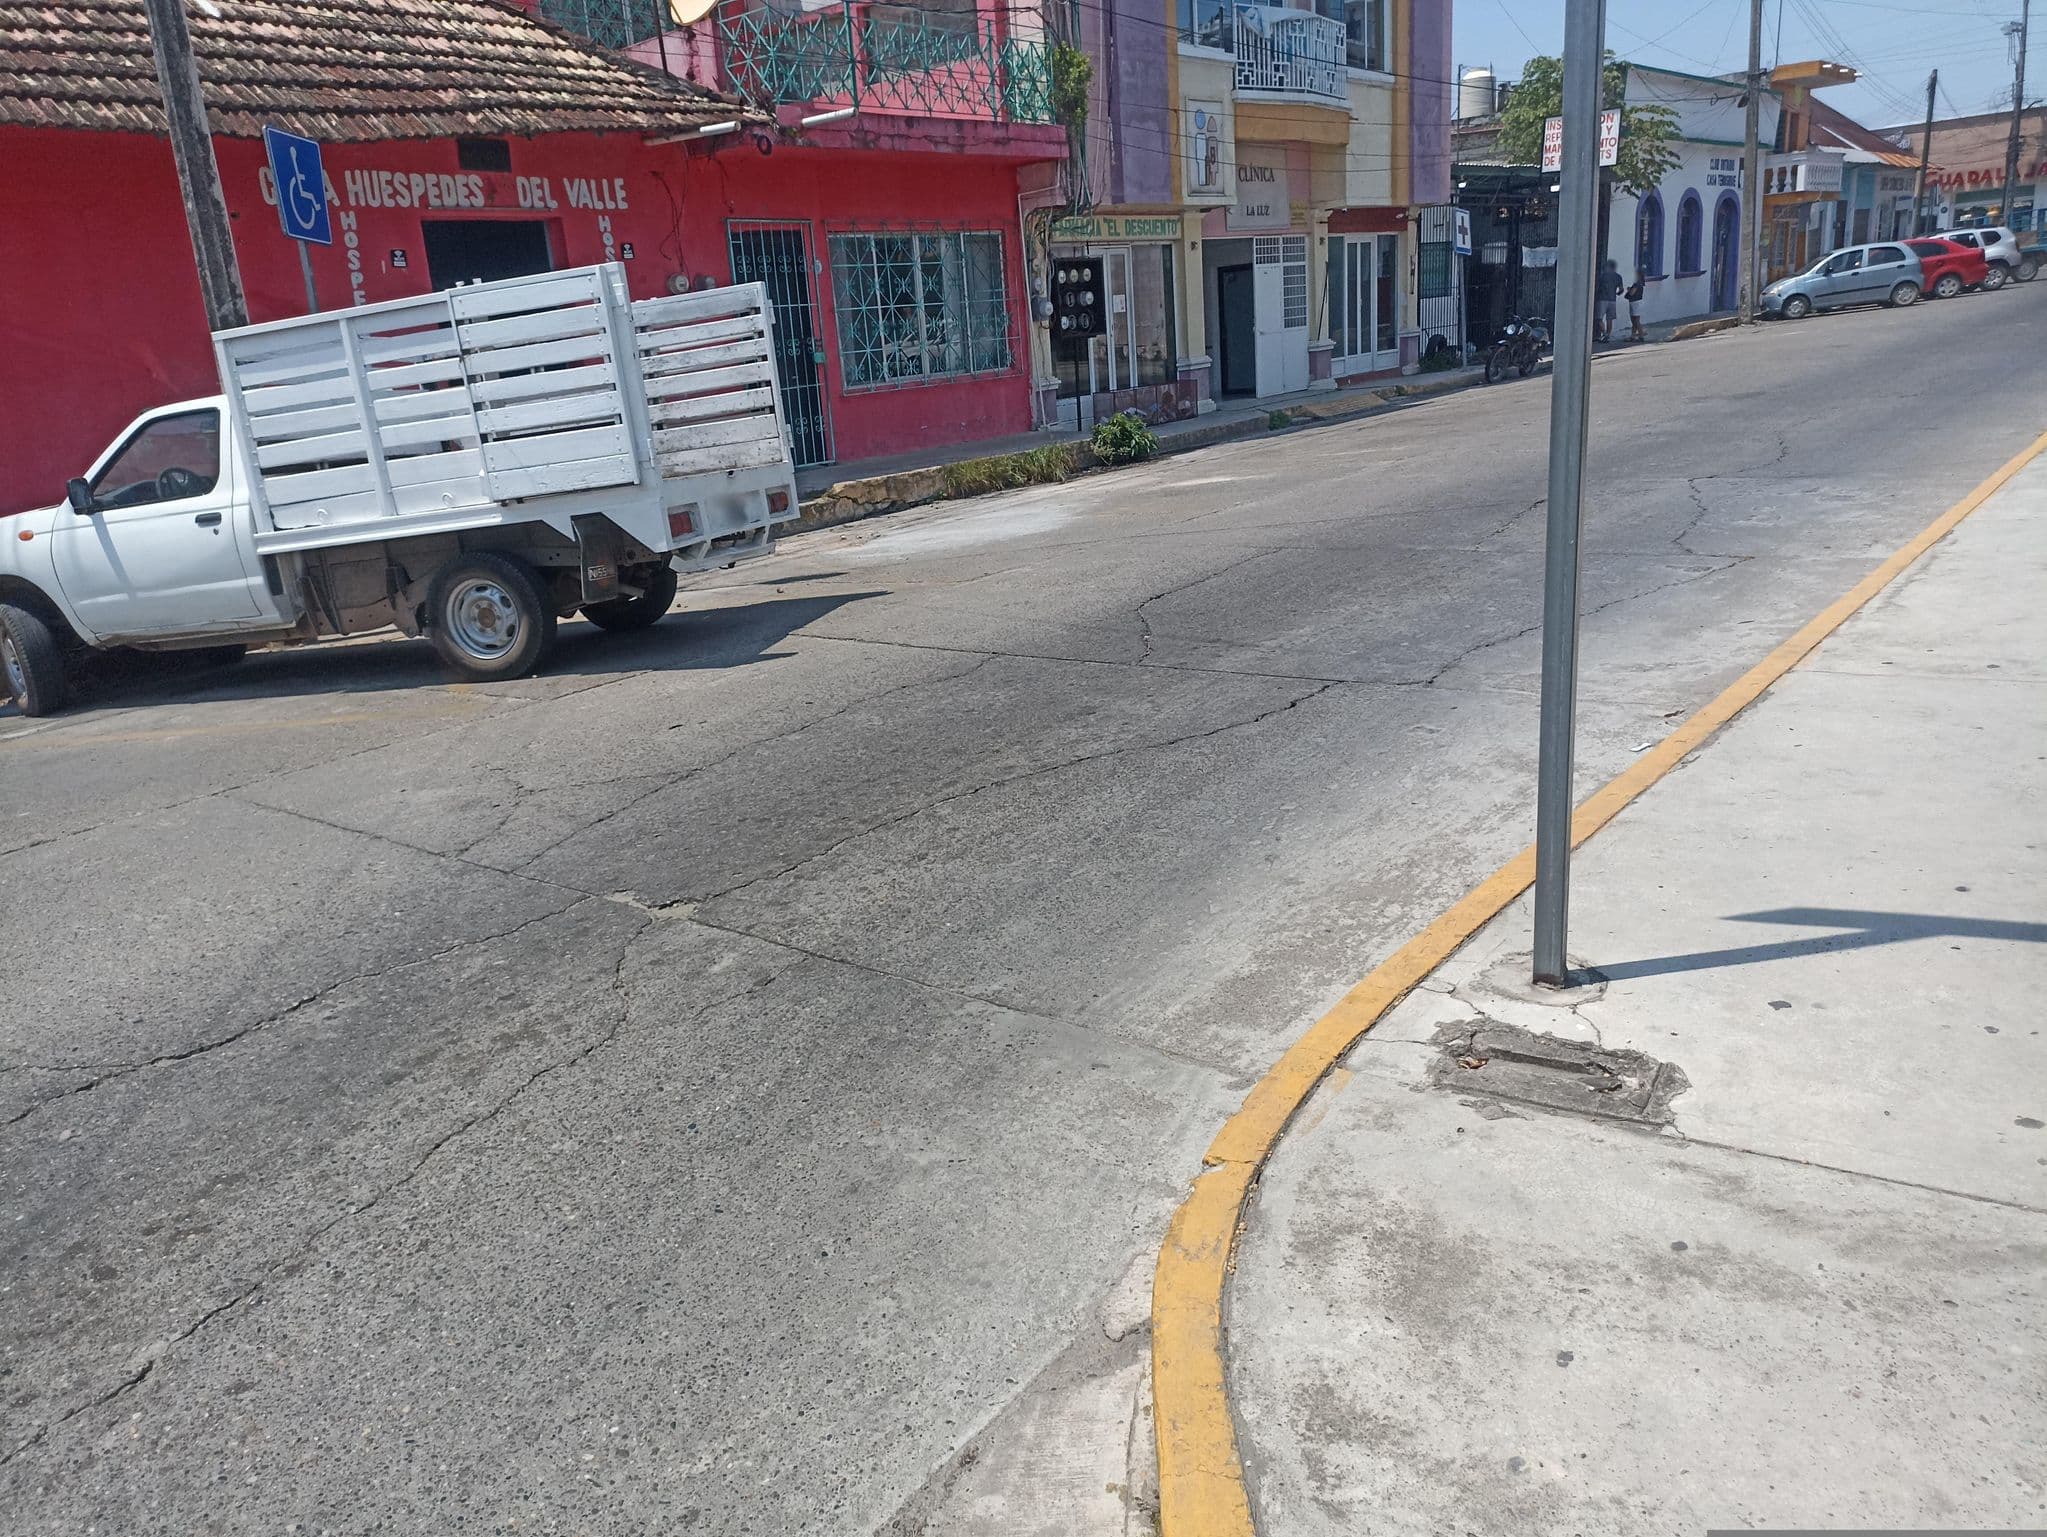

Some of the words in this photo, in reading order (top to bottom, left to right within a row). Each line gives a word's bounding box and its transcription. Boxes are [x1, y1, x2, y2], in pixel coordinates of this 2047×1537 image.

[1544, 156, 1555, 166] DE
[1238, 162, 1275, 182] CLÍNICA
[345, 169, 485, 208] HUESPEDES
[515, 176, 558, 209] DEL
[563, 177, 628, 210] VALLE
[1246, 205, 1255, 216] LA
[1256, 205, 1270, 216] LUZ
